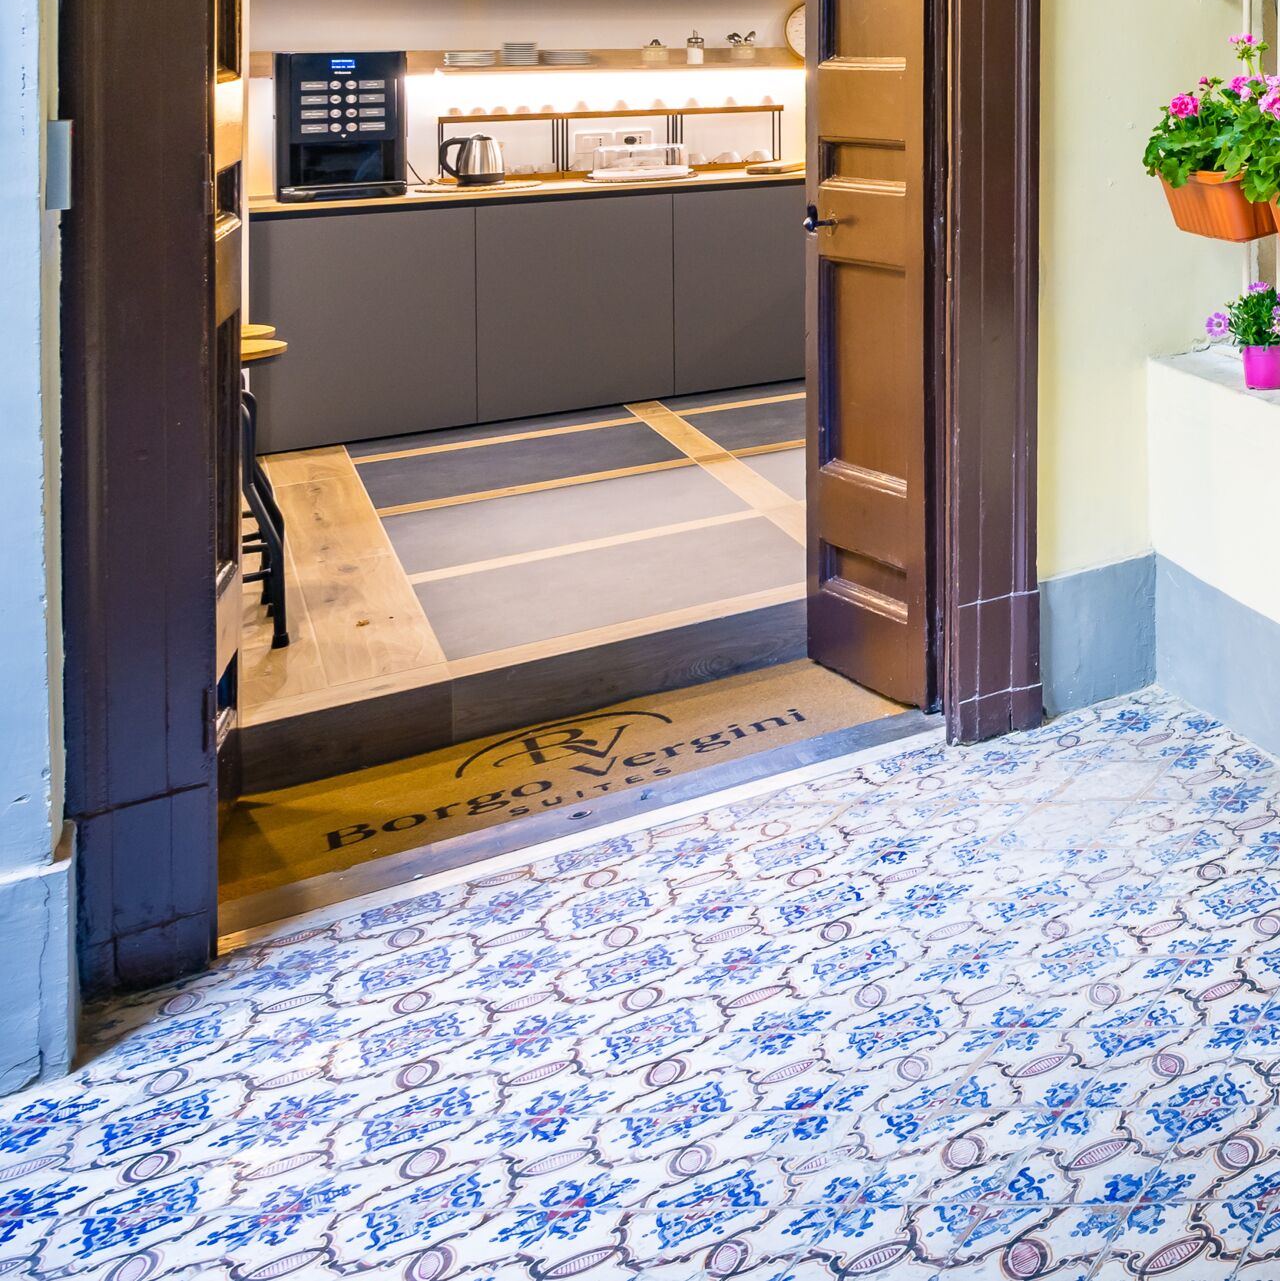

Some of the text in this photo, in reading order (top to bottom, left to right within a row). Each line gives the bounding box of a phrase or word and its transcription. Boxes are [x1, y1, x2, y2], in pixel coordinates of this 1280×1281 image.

[322, 708, 807, 852] Borgo Vergini
[509, 766, 672, 817] SUITES
